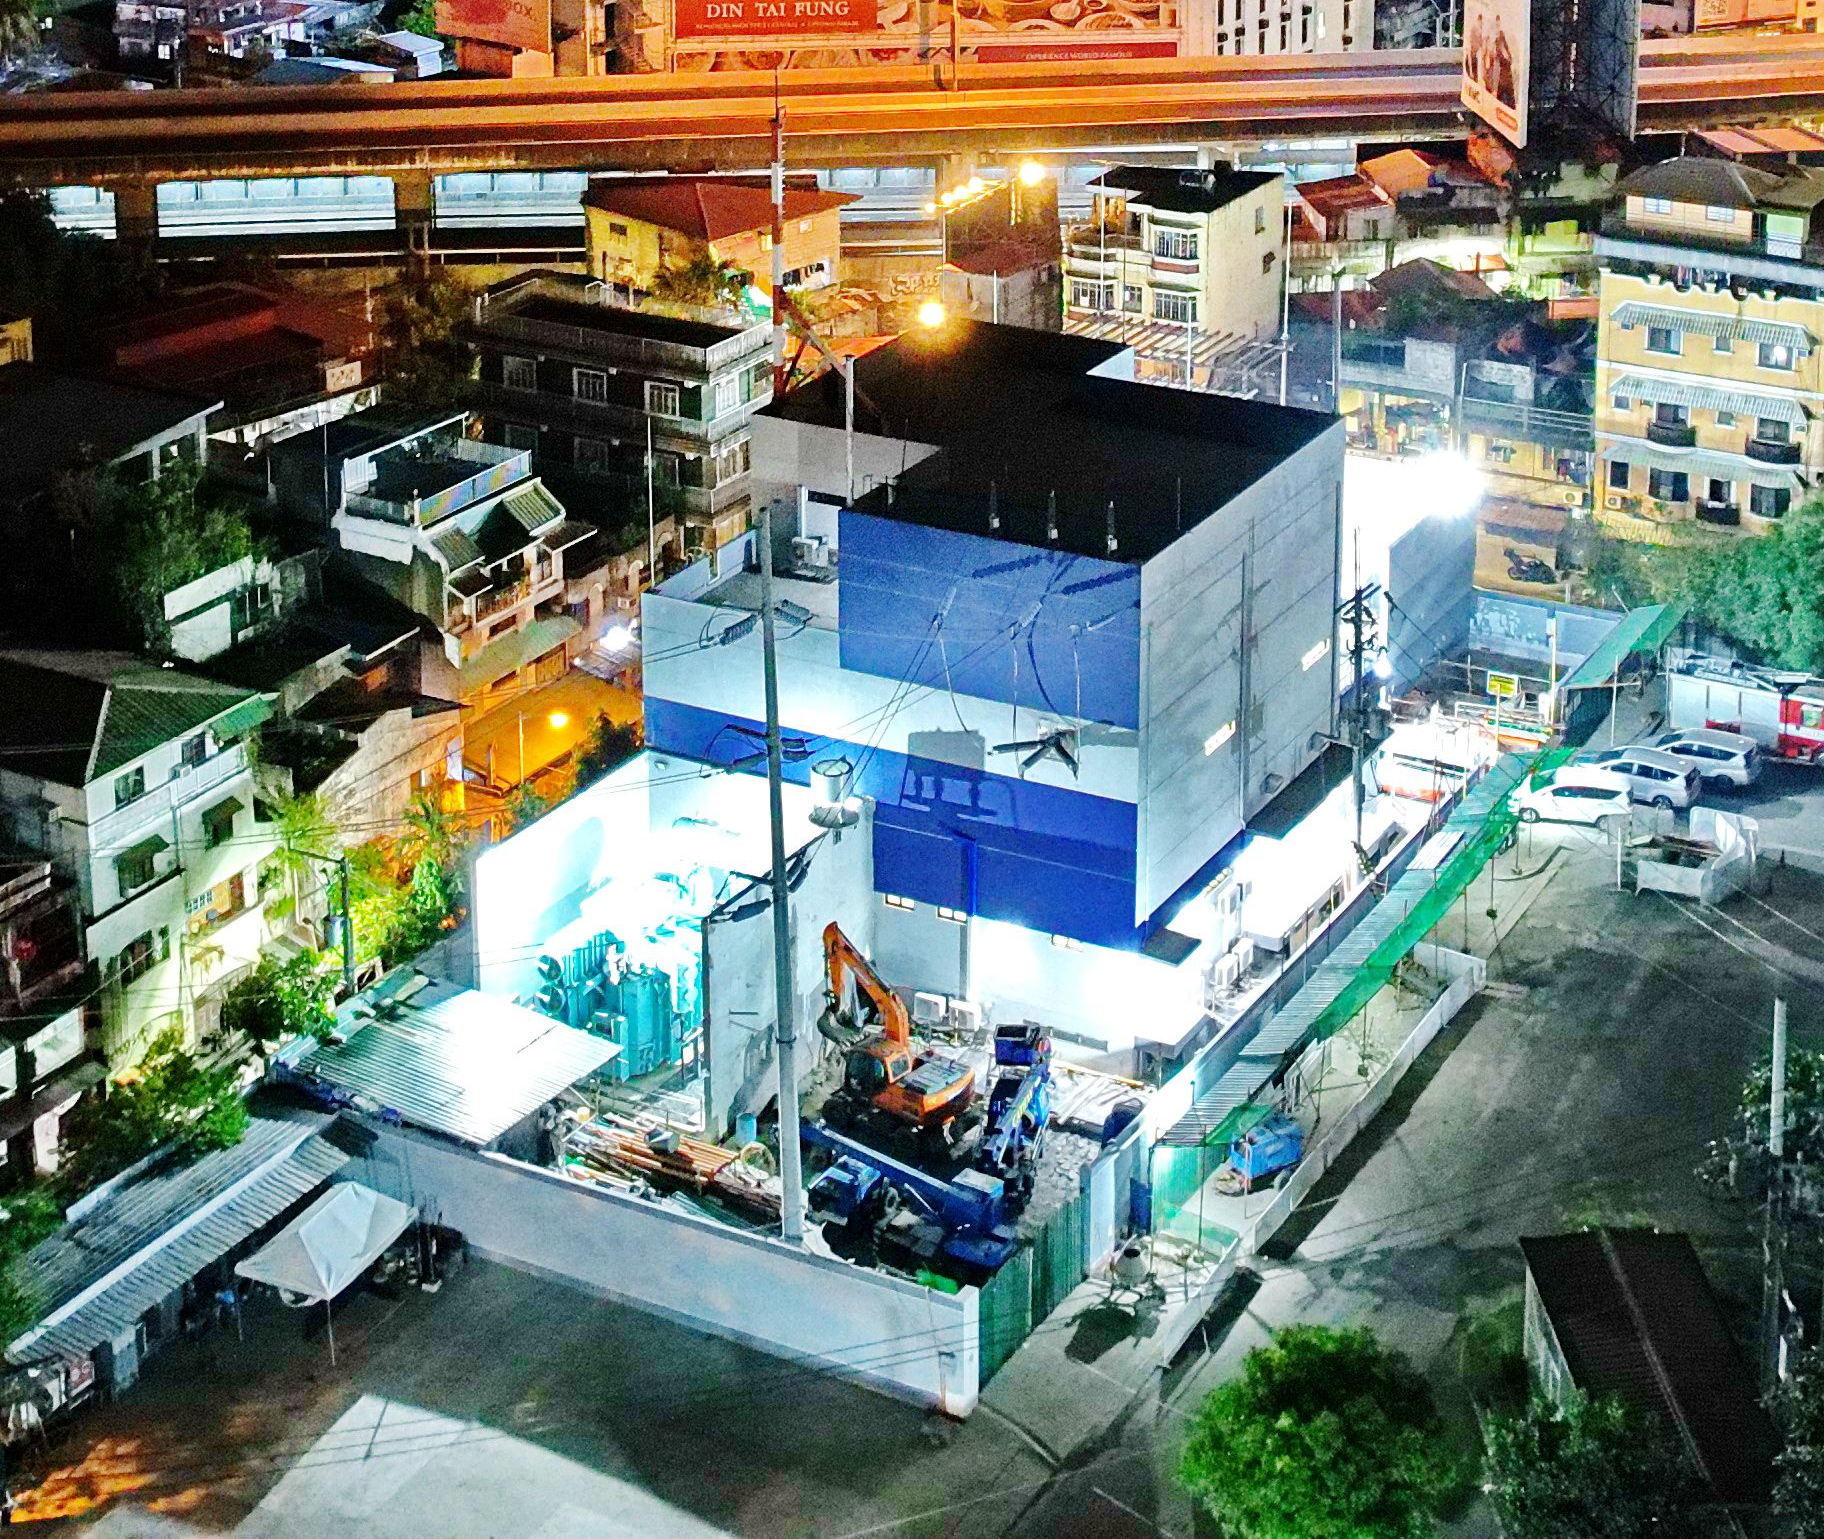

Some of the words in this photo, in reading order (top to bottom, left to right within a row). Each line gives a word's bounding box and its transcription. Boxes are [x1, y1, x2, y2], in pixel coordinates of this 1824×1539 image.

[706, 2, 744, 19] DIN
[754, 1, 786, 17] TAI
[794, 0, 850, 17] FUNG
